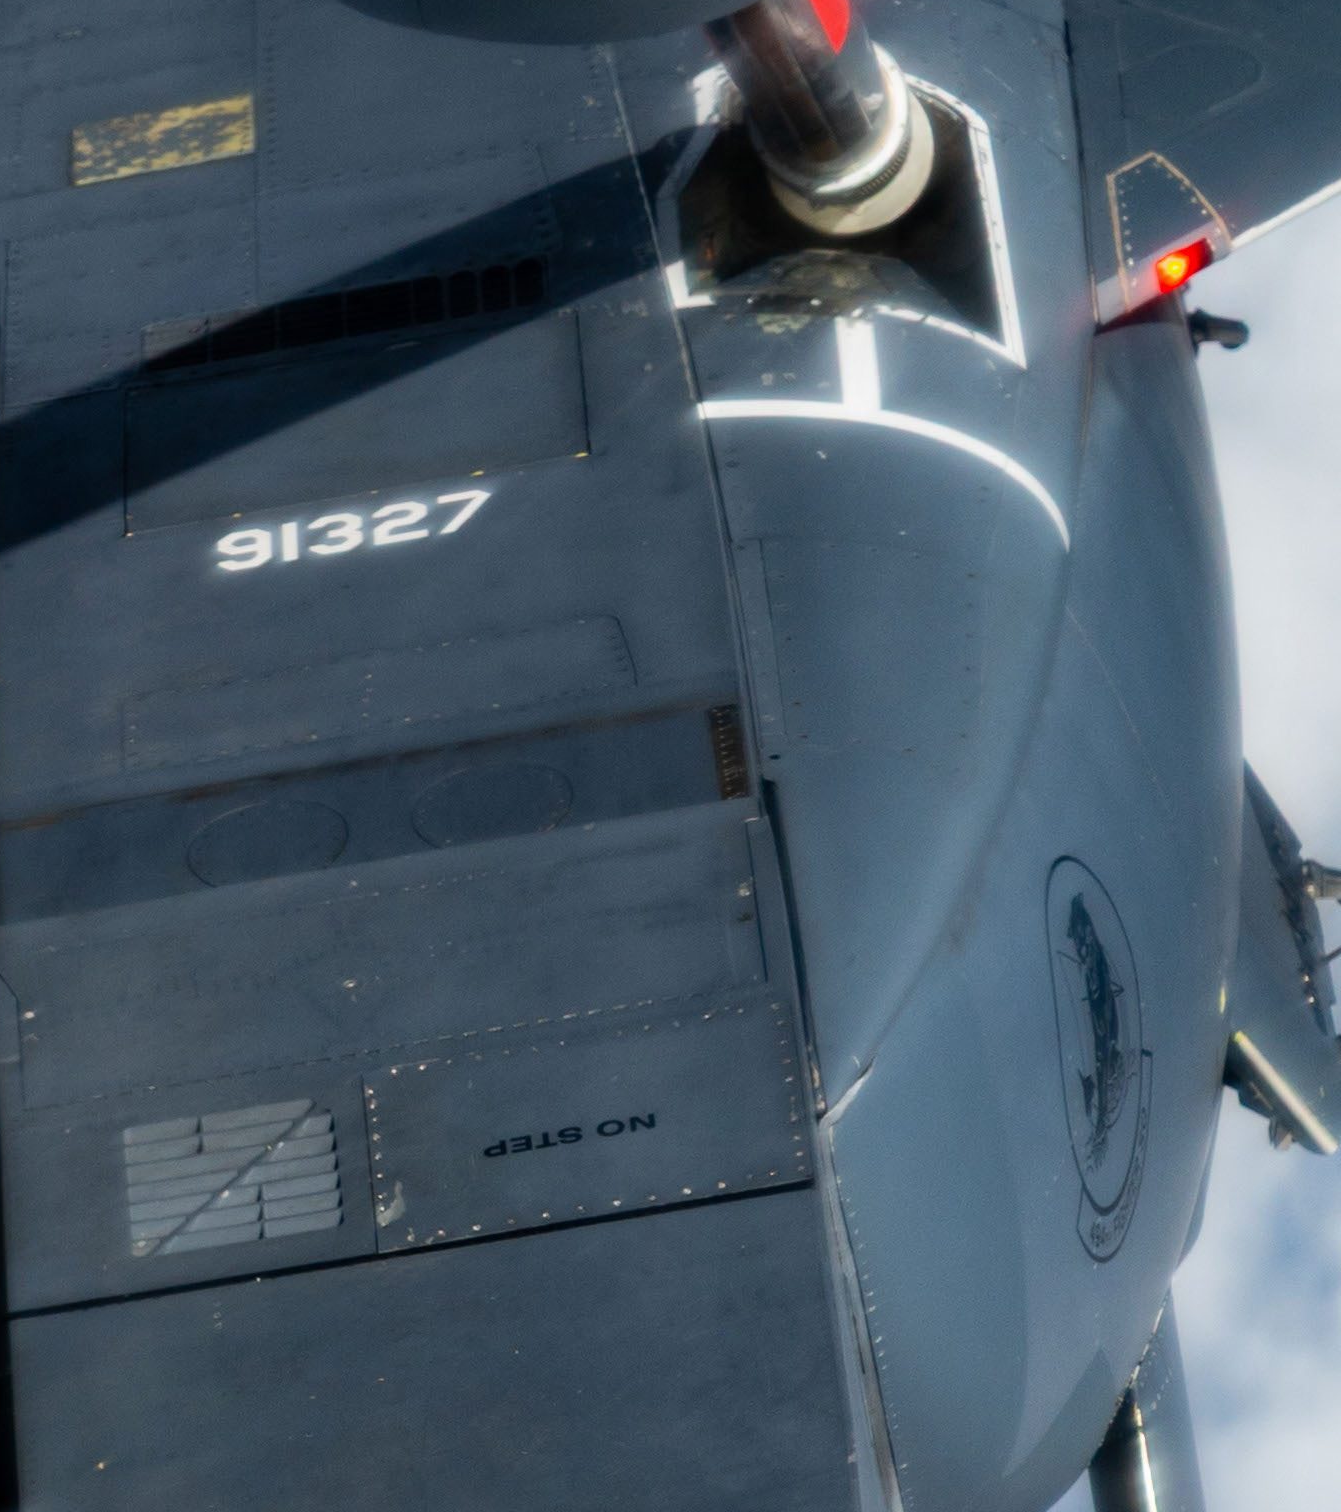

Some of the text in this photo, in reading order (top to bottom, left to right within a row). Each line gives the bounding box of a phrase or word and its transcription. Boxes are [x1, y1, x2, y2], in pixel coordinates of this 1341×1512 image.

[215, 489, 493, 573] 91327
[483, 1112, 657, 1159] NO STEP
